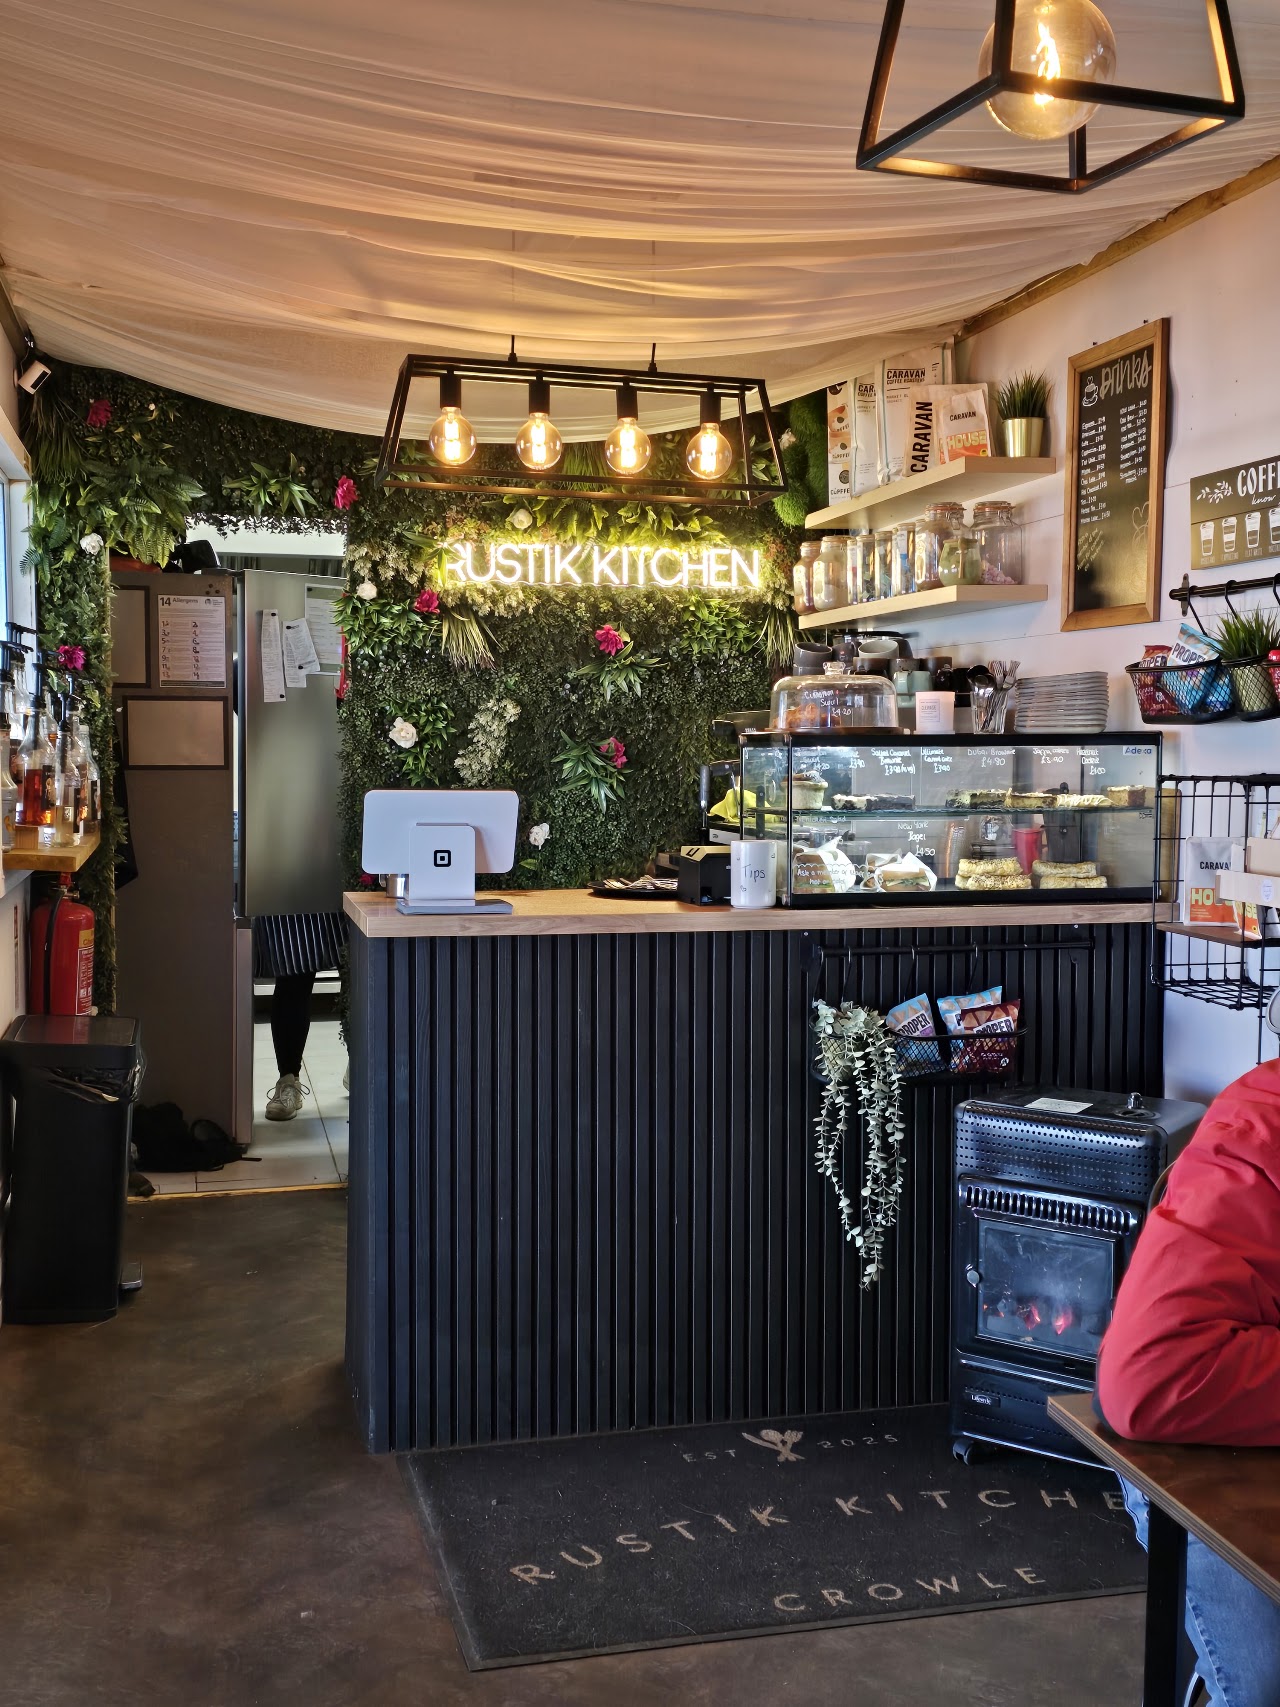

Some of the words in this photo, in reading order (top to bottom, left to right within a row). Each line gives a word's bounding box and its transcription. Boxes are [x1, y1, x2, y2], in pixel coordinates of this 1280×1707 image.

[886, 368, 926, 380] CARAVAN
[858, 384, 876, 393] CAR
[949, 411, 977, 422] CARAVAN
[910, 401, 933, 473] CARAVAN
[947, 430, 987, 450] HOUSE
[1237, 460, 1280, 497] COFF
[443, 542, 582, 585] RUSTIK
[593, 544, 761, 589] KITCHEN
[160, 597, 171, 606] 14
[742, 863, 766, 883] Tips
[1199, 861, 1231, 870] CARAVA
[682, 1449, 736, 1463] EST
[817, 1434, 898, 1449] 2025
[509, 1506, 791, 1585] RUSTIK
[835, 1489, 1126, 1516] KITCHE
[774, 1567, 1046, 1611] CROWLE
